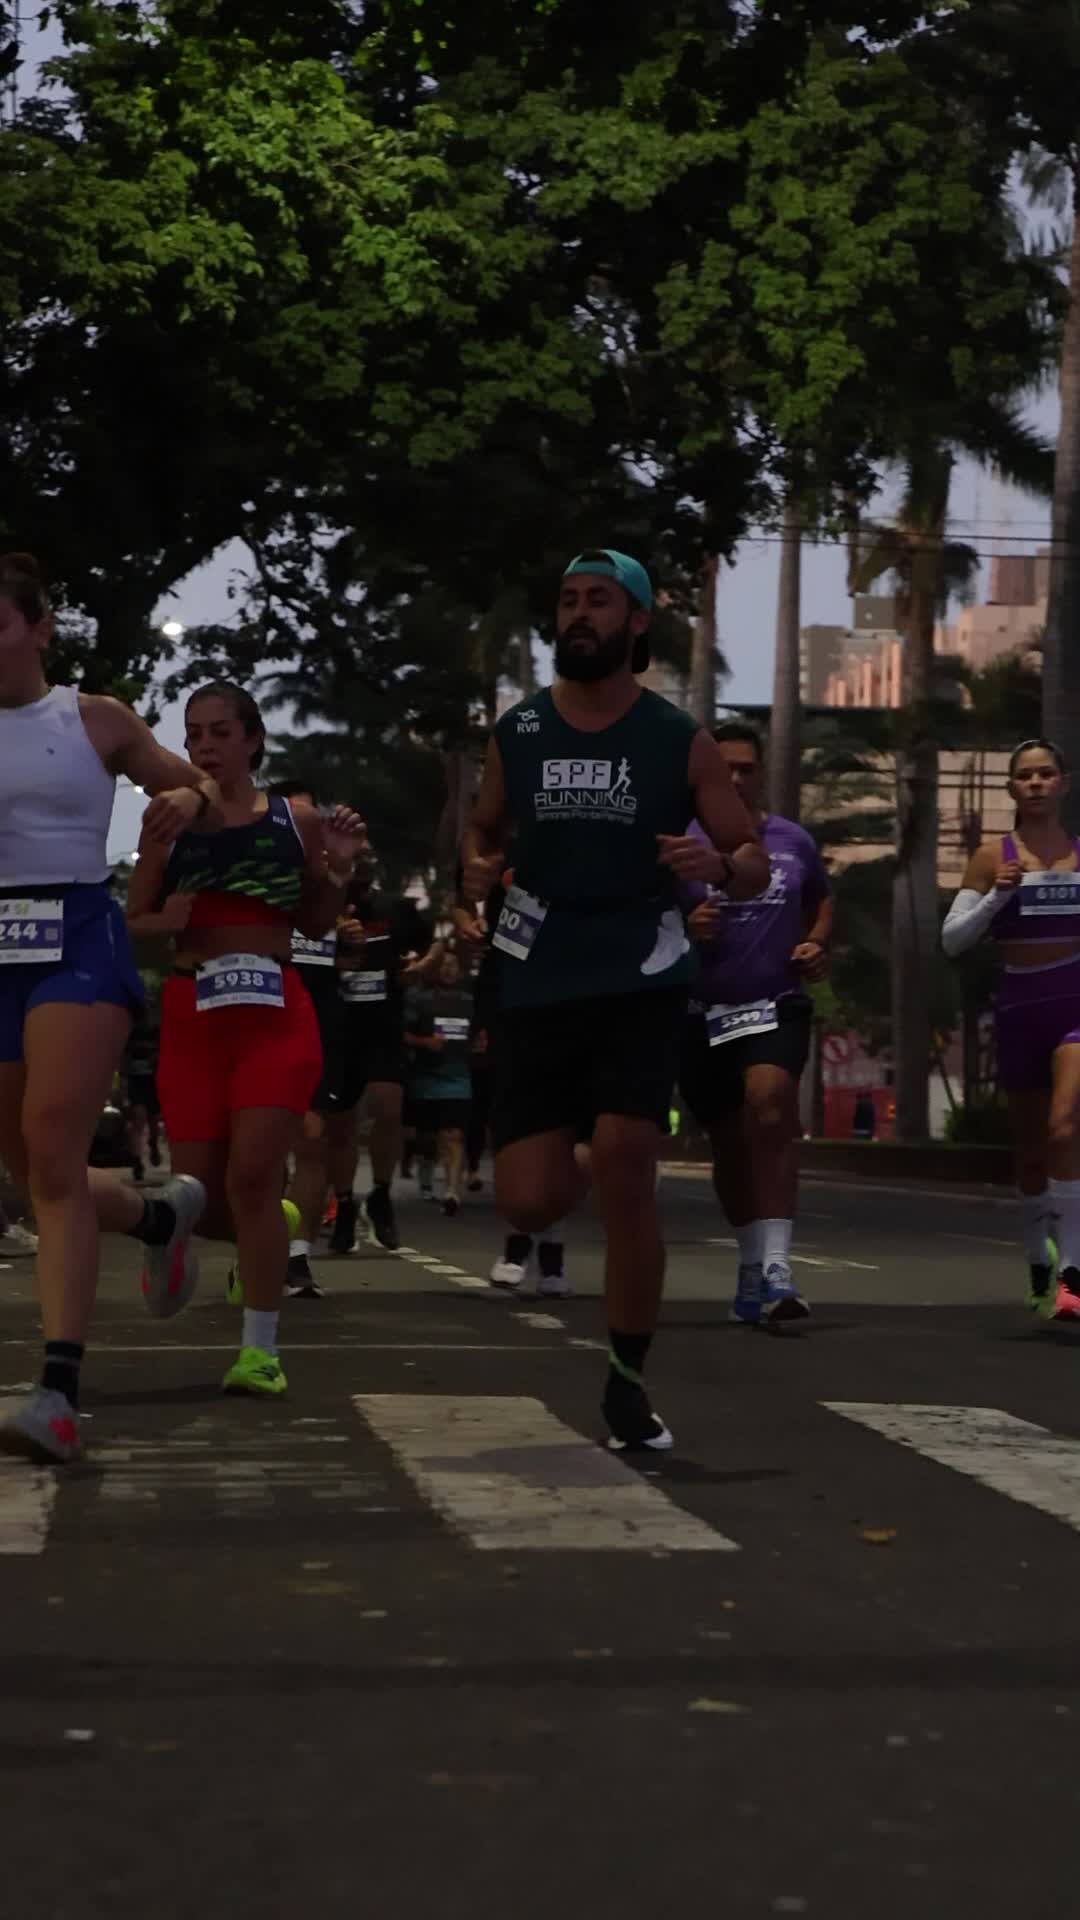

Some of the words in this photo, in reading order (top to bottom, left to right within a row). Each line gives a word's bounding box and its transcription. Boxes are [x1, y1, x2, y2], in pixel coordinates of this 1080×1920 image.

[517, 721, 541, 734] RVB
[547, 761, 606, 786] SPF
[533, 791, 638, 811] RUNNING
[1035, 887, 1077, 900] 6101
[214, 970, 265, 991] 5938
